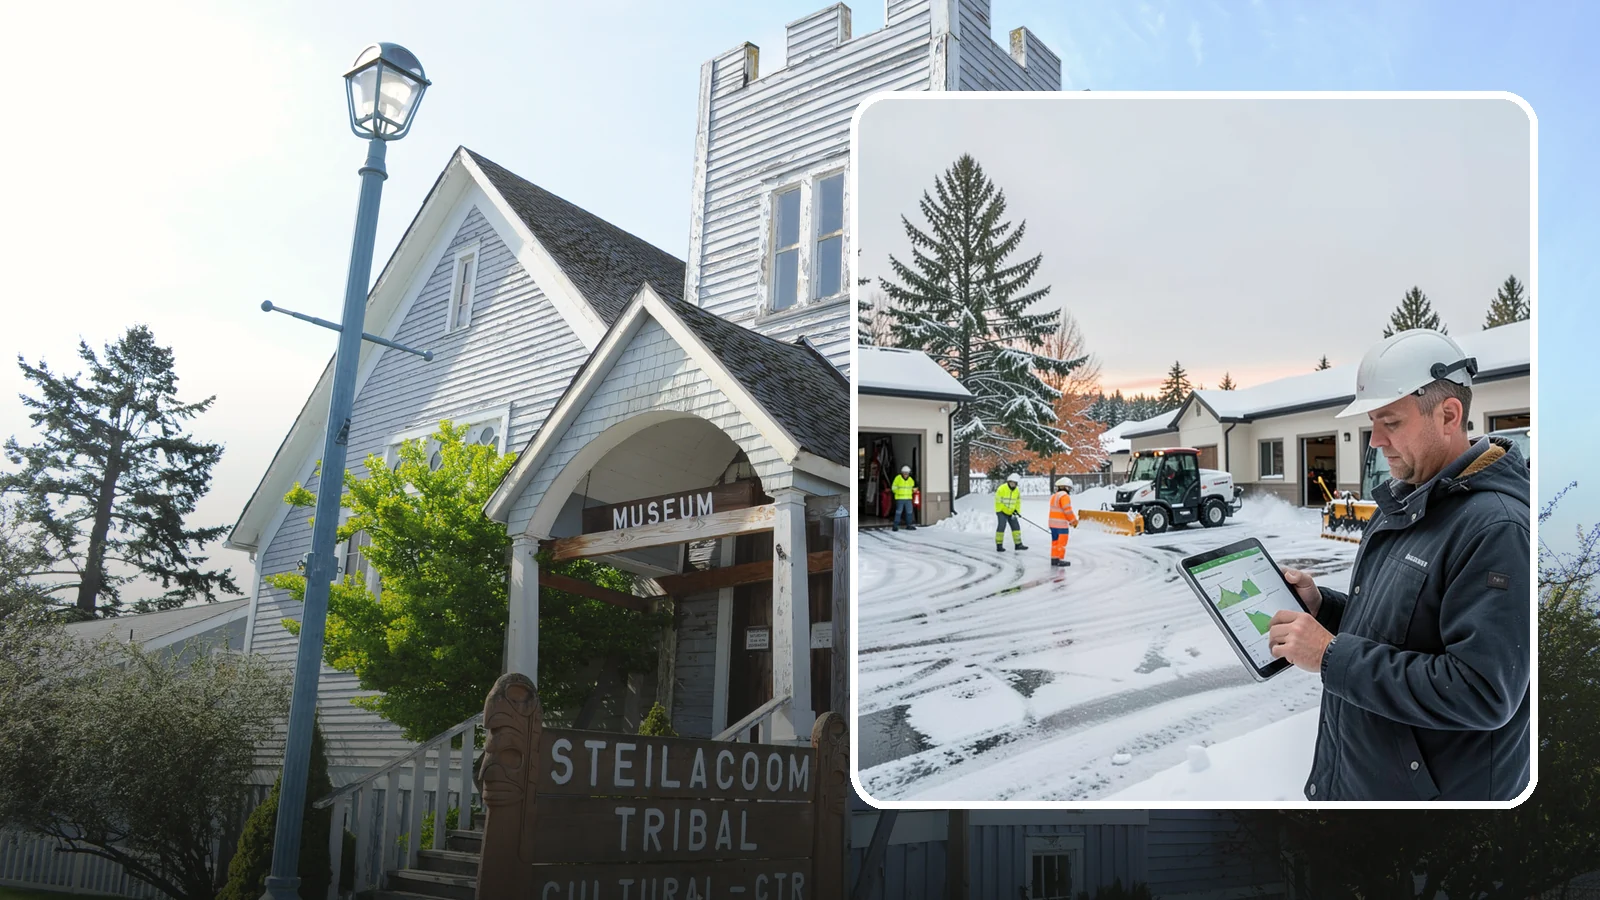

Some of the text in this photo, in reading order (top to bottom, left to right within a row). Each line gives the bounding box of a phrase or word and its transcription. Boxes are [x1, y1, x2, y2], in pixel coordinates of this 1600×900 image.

[613, 491, 713, 531] MUSEUM
[551, 738, 809, 792] STEILACOOM
[615, 806, 758, 851] TRIBAL
